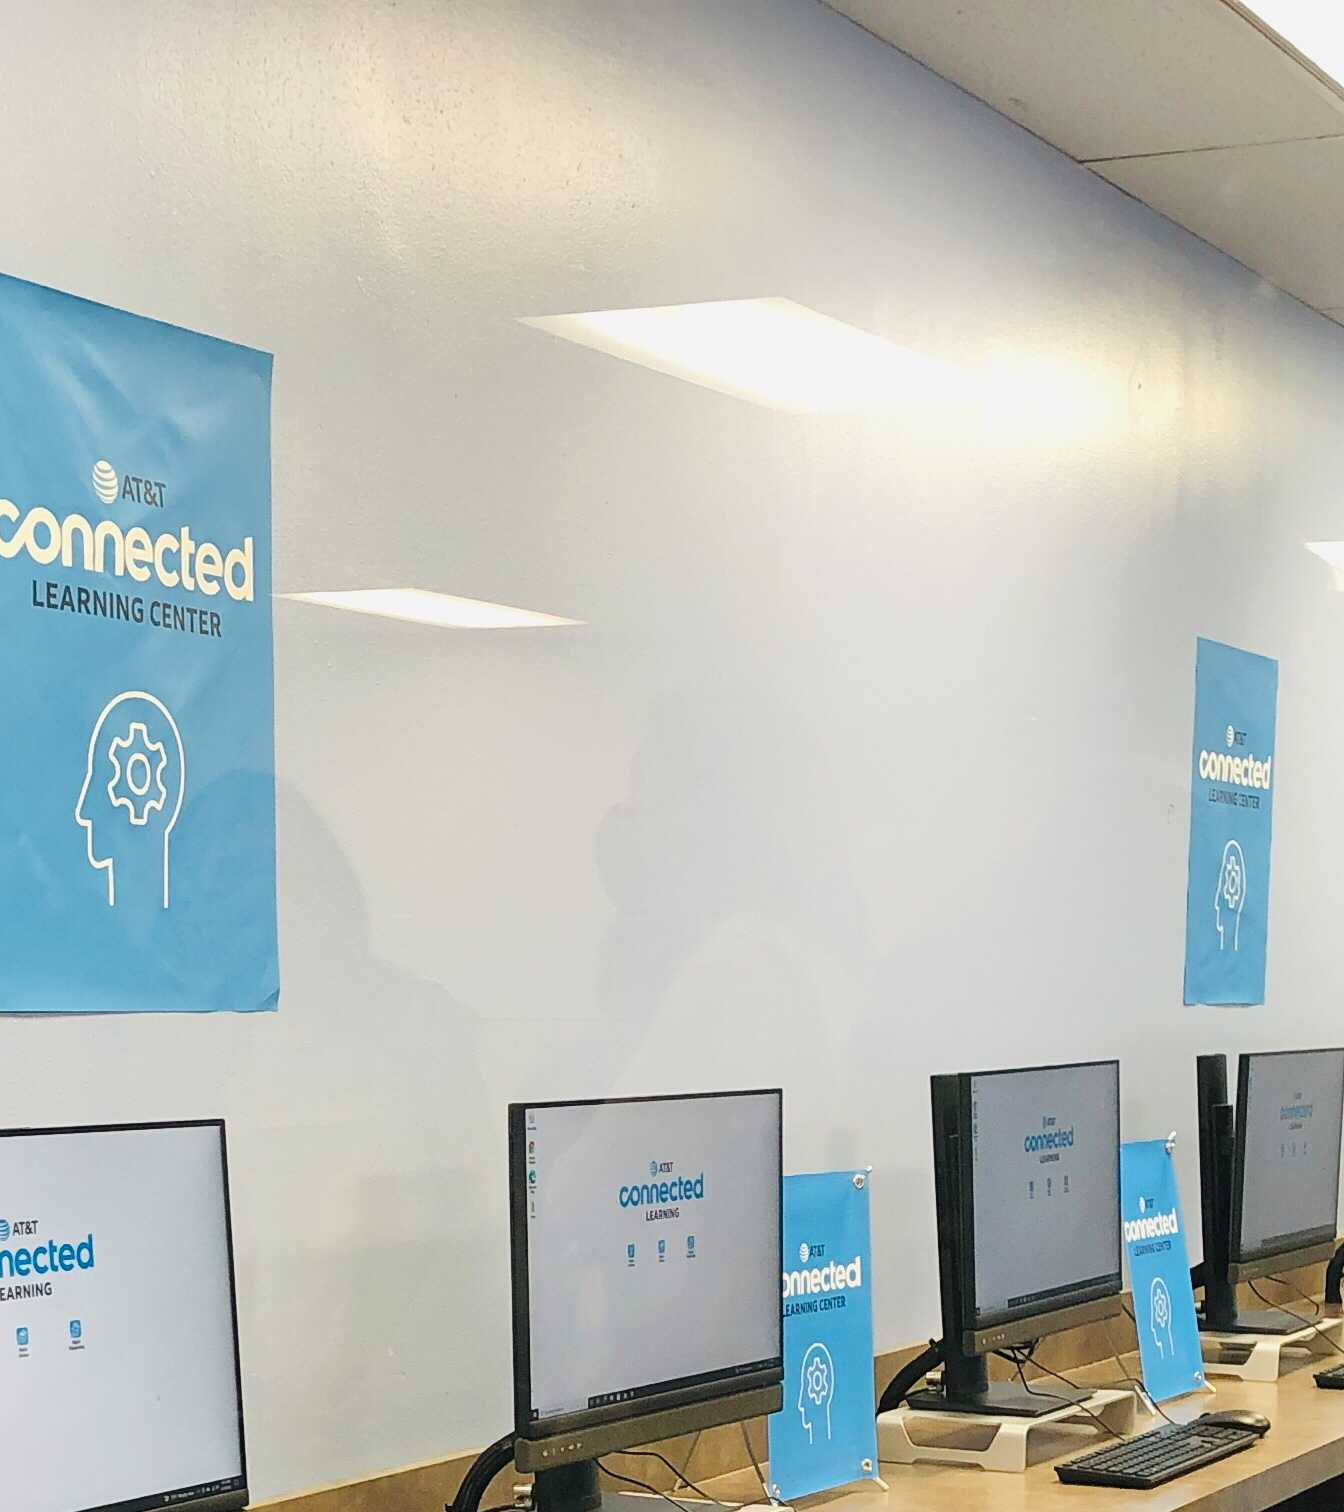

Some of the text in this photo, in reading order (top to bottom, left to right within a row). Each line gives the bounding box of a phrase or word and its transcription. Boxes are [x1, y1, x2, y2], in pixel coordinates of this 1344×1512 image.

[122, 475, 167, 508] AT&T
[32, 580, 222, 637] LEARNING CENTER
[1199, 749, 1272, 790] connected
[619, 1171, 704, 1208] connected
[12, 1220, 39, 1236] AT&T
[645, 1207, 680, 1222] LEARNING
[1124, 1207, 1179, 1243] connected
[782, 1256, 862, 1298] onnected
[819, 1295, 846, 1312] CENTER
